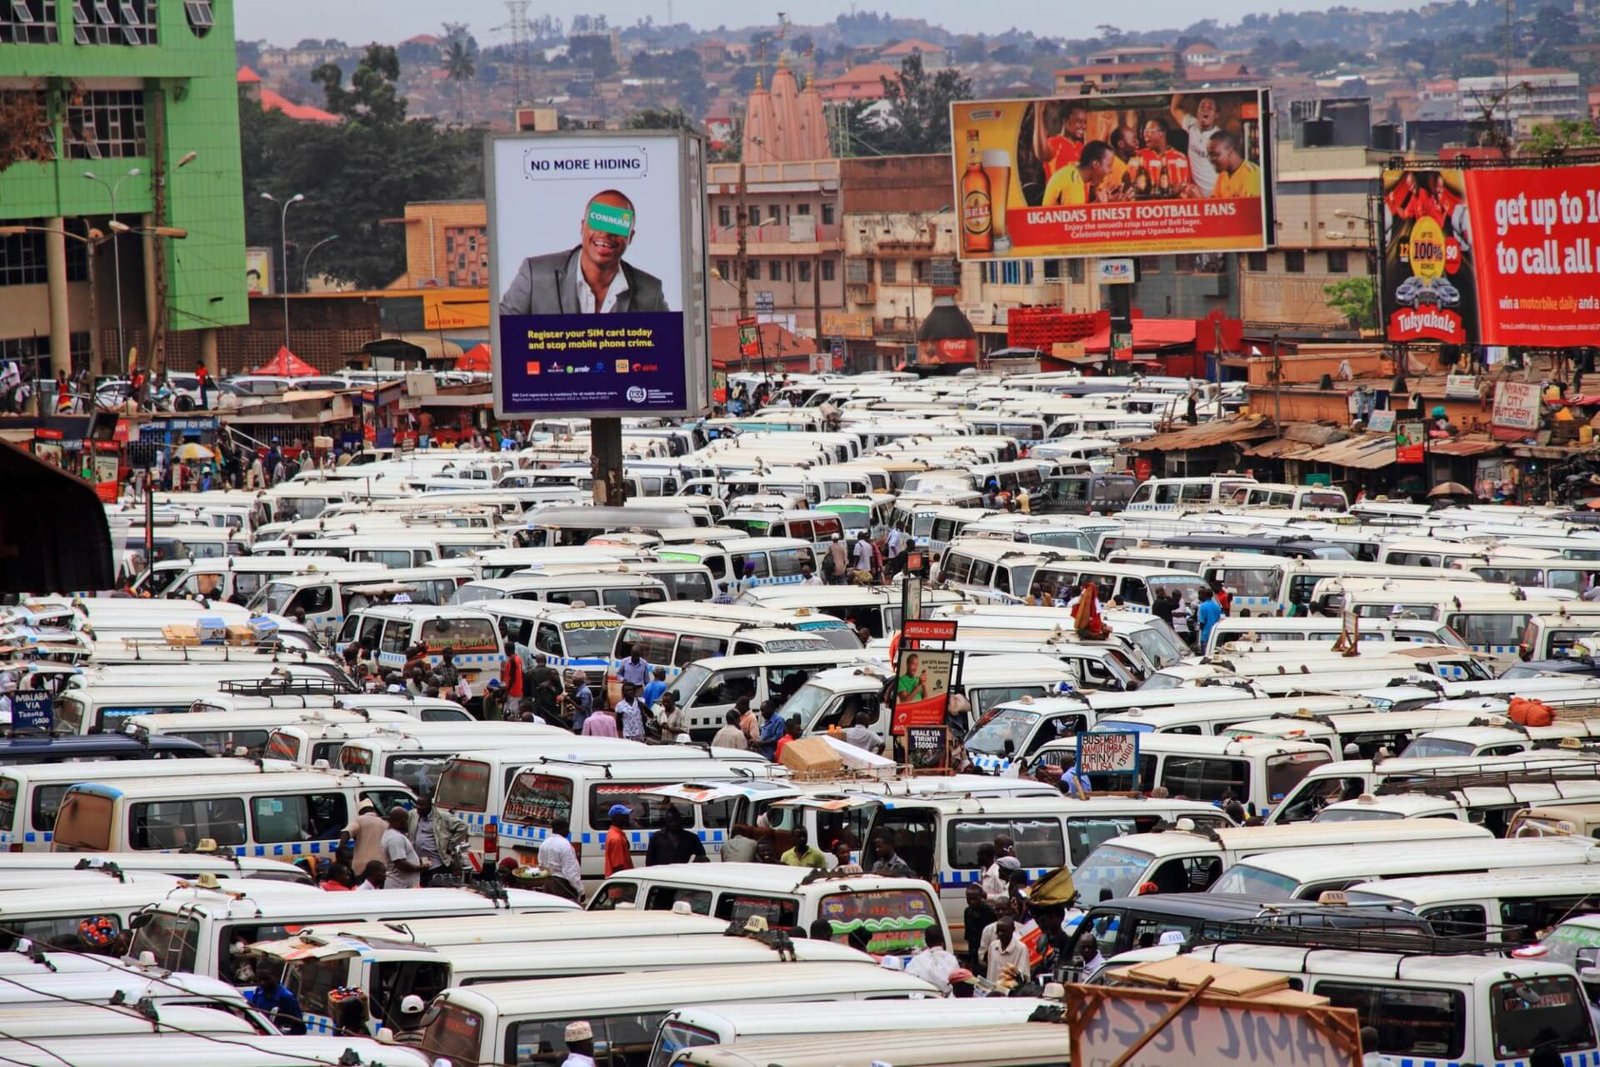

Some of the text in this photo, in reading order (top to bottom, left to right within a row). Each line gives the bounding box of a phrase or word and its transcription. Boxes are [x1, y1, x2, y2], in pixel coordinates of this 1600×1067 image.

[531, 158, 641, 171] NO MORE HIDING
[964, 206, 990, 217] BELL
[1026, 202, 1236, 225] UGANDA'S FINEST FOOTBALL FANS
[1495, 189, 1600, 236] get up to 1
[589, 211, 631, 228] CONMAN
[1064, 223, 1083, 232] Enjoy
[1097, 222, 1124, 230] smooth
[1124, 220, 1141, 229] crisp
[1070, 230, 1110, 239] Celebrating
[1132, 228, 1146, 236] step
[1147, 227, 1174, 236] Uganda
[1414, 242, 1443, 260] 100%
[1446, 246, 1458, 259] 90
[1496, 237, 1593, 275] to call all
[1499, 295, 1600, 313] win a motorbike daily and a
[1398, 310, 1455, 333] Tukyakale
[528, 328, 653, 340] Register your SIM card today
[528, 339, 655, 352] and stop mobile phone crime.
[1505, 382, 1530, 396] NYANZI
[1507, 395, 1524, 406] CITY
[1495, 406, 1530, 419] BUTCHERY
